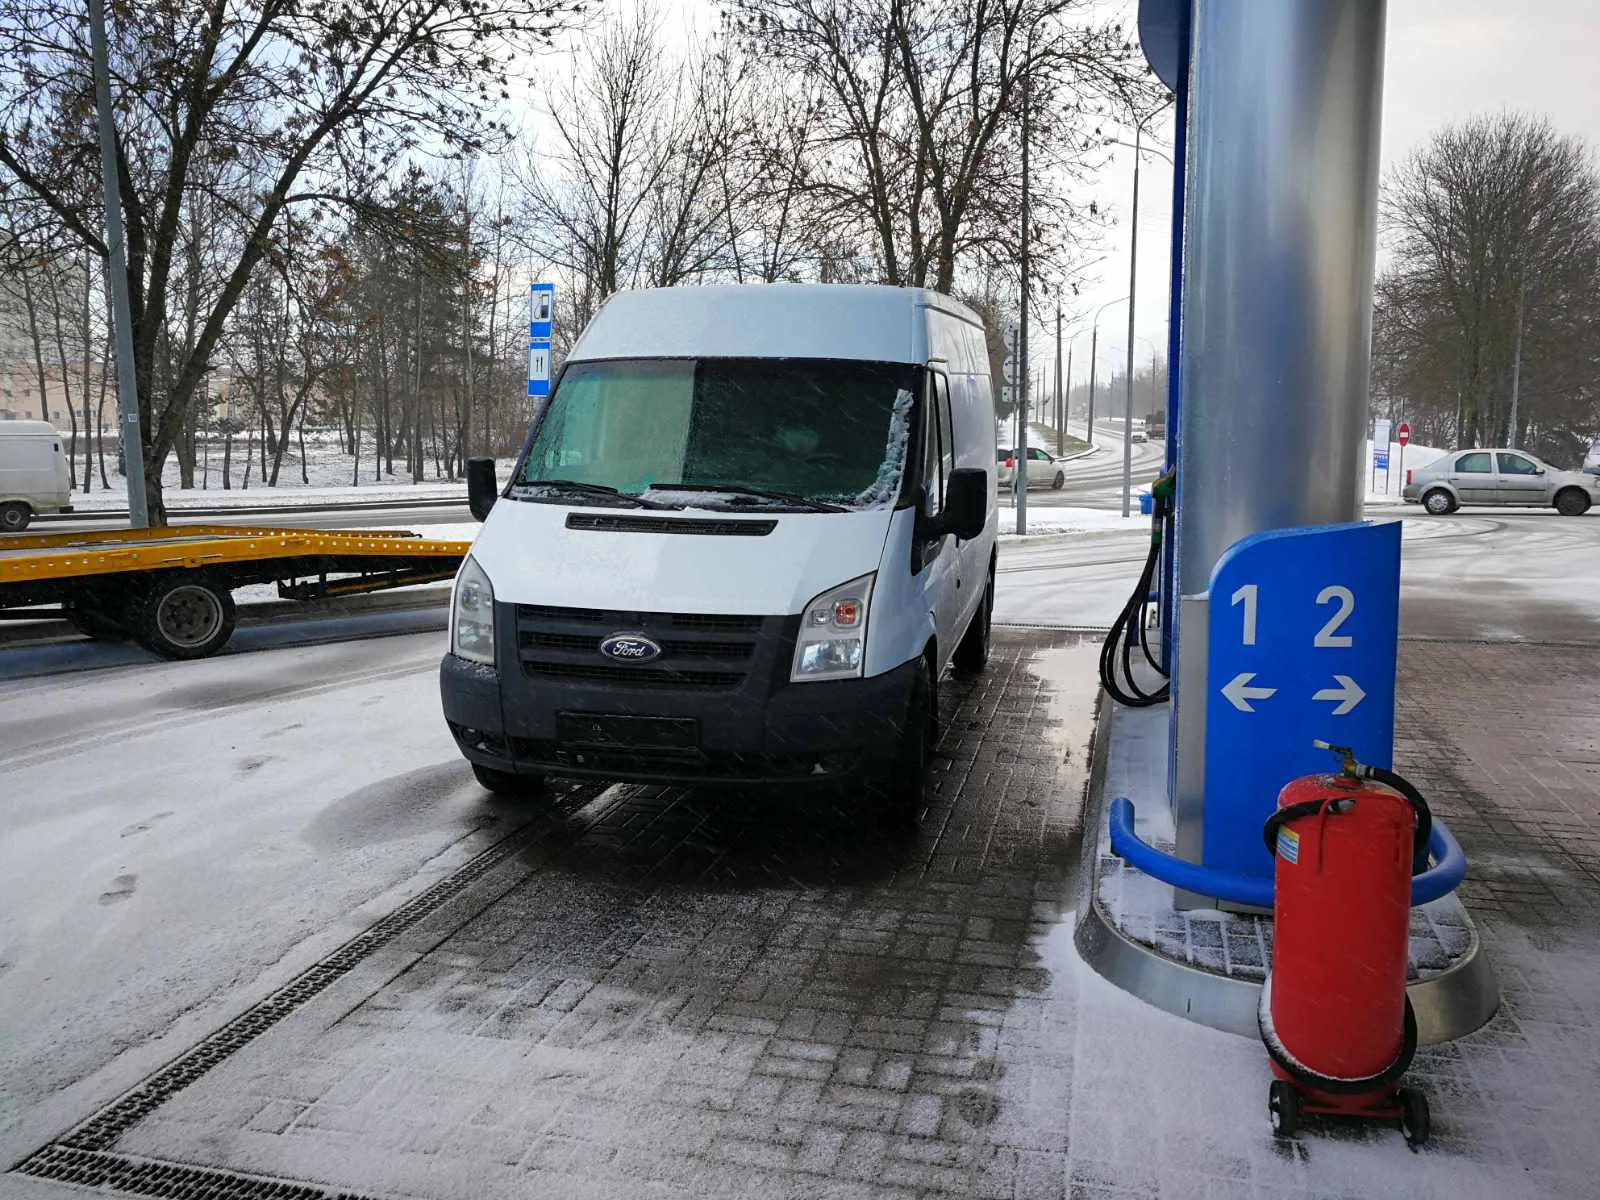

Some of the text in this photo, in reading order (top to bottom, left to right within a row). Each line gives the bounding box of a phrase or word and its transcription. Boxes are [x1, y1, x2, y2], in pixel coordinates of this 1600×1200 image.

[1231, 584, 1258, 646] 1
[1314, 585, 1355, 647] 2
[612, 640, 647, 656] Ford
